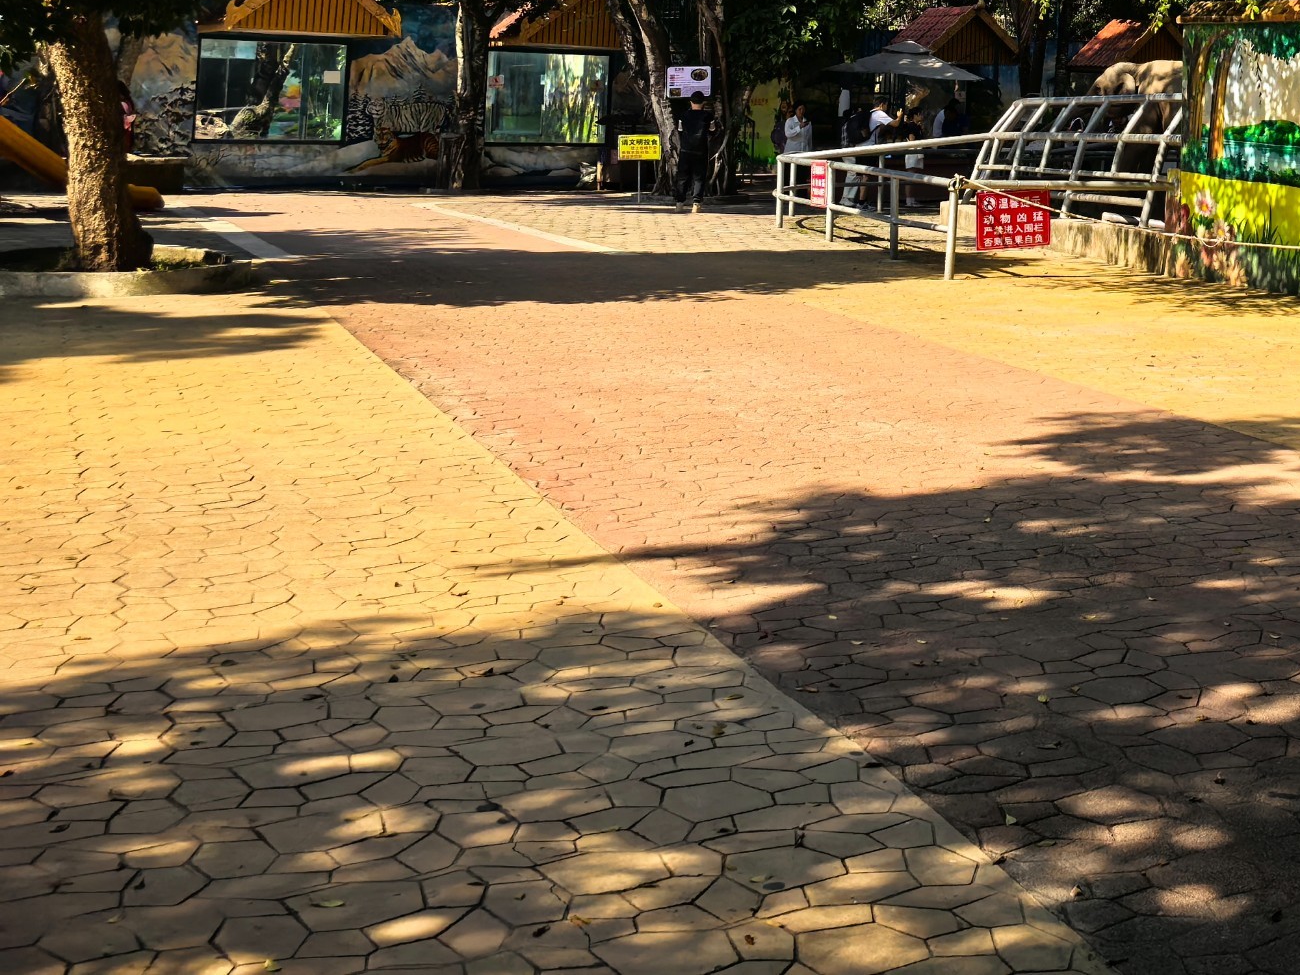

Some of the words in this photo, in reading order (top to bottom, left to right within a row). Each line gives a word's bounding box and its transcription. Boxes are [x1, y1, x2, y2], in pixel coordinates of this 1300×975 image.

[983, 211, 1044, 225] 动物凶猛
[983, 223, 1044, 236] 严禁进入围栏
[983, 234, 1043, 247] 否则后果自负
